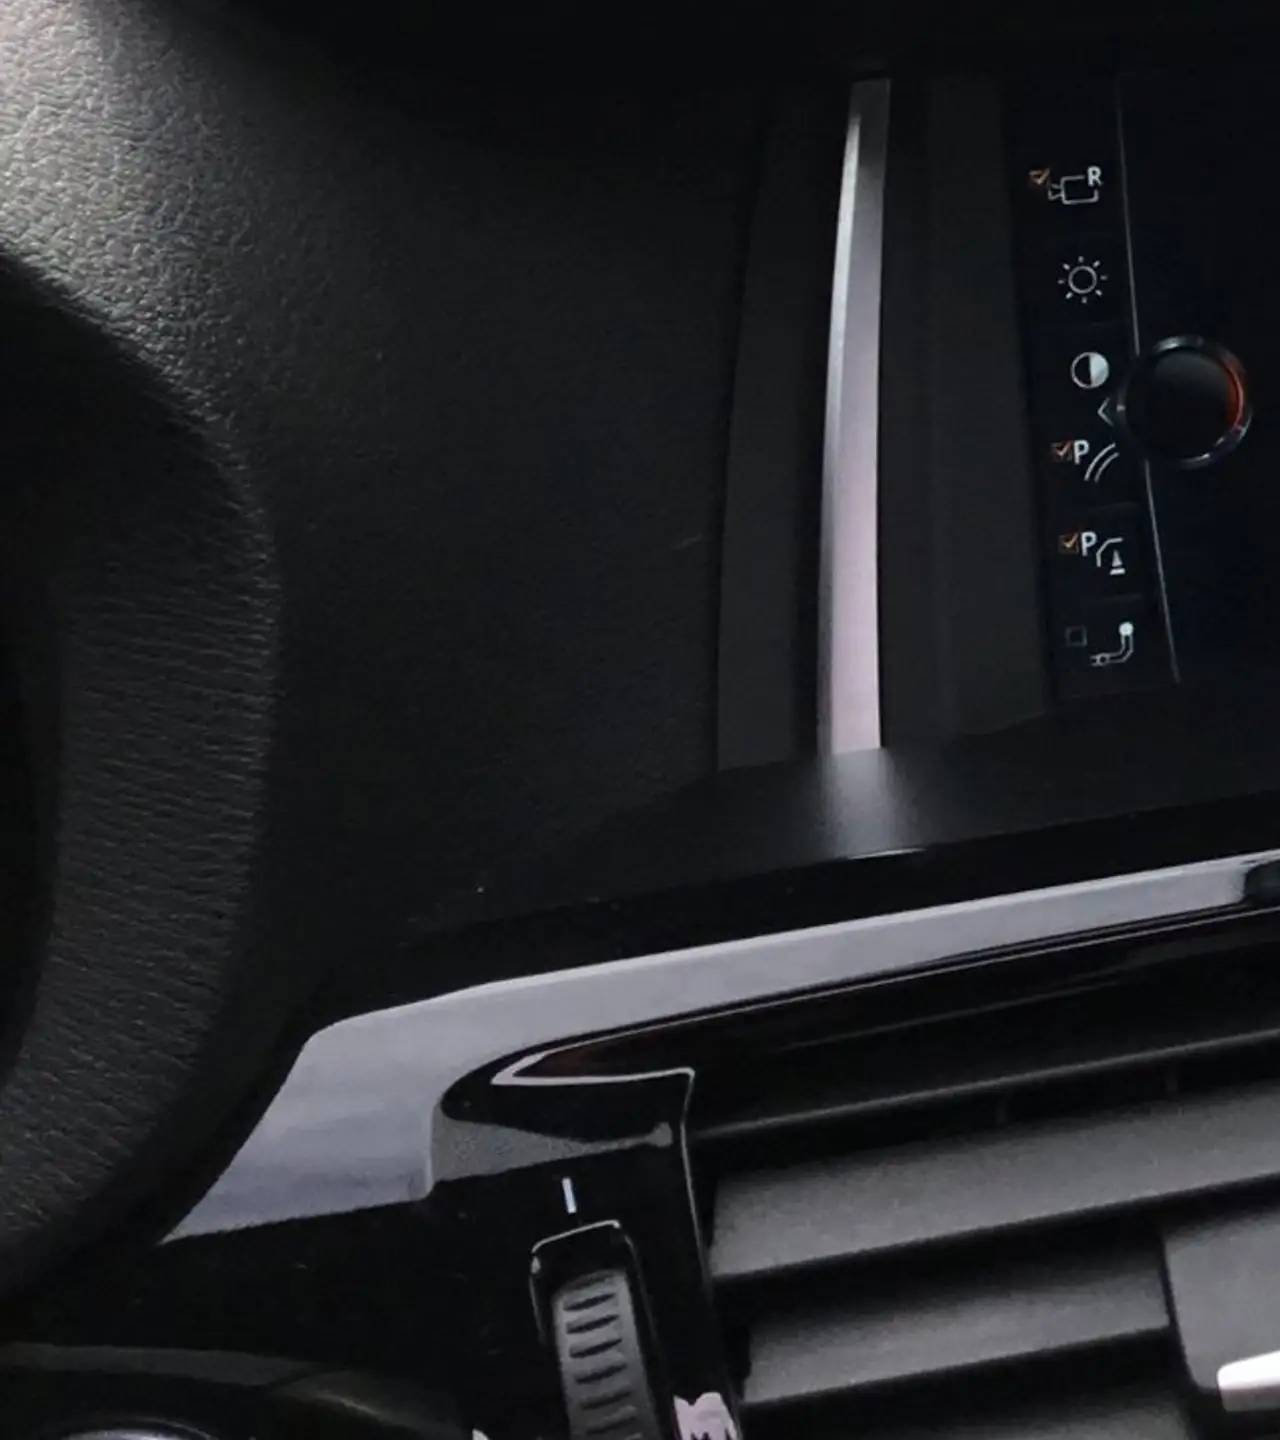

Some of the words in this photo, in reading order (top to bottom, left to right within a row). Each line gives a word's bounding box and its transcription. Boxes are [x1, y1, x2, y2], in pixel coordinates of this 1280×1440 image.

[1087, 165, 1103, 186] R
[1073, 439, 1089, 464] P
[1081, 530, 1097, 556] P
